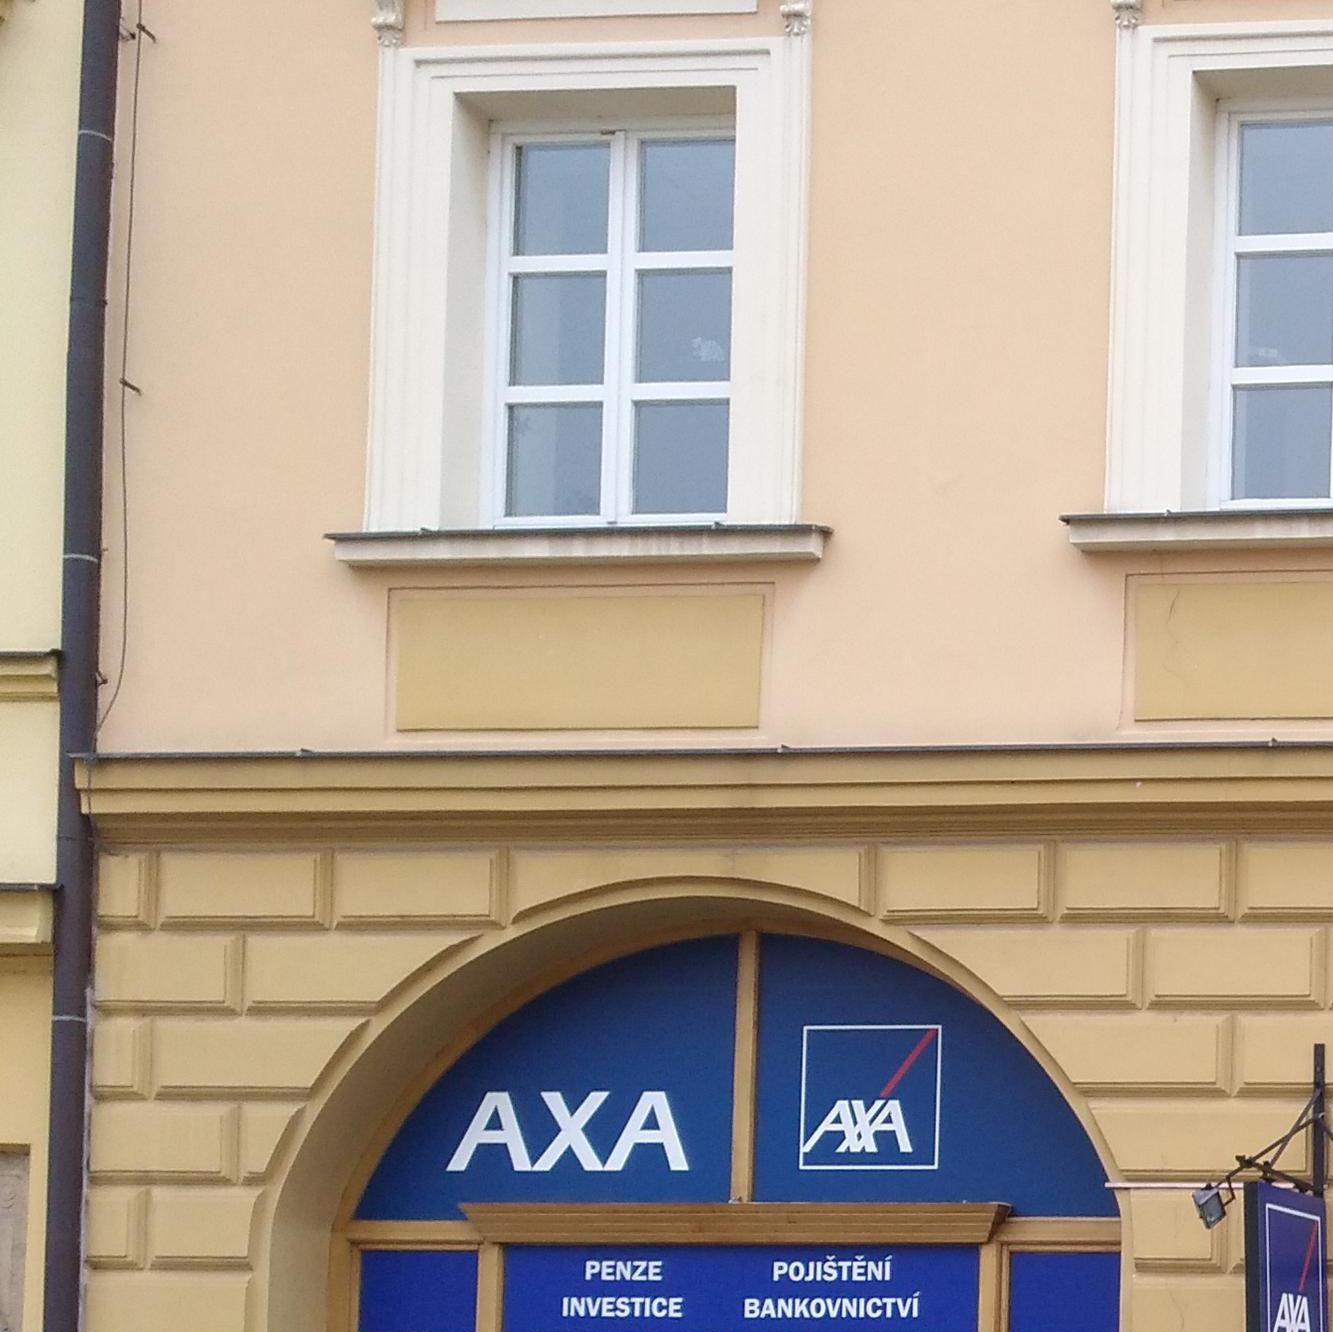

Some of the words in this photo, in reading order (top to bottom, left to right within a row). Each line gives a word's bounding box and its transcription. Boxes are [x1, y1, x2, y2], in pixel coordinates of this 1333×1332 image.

[446, 1090, 690, 1172] AXA
[803, 1098, 914, 1154] AXA
[584, 1260, 663, 1281] PENZE
[772, 1254, 893, 1282] POJIŠTĚNÍ
[561, 1296, 684, 1318] INVESTICE
[743, 1291, 921, 1319] BANKOVNICTVÍ
